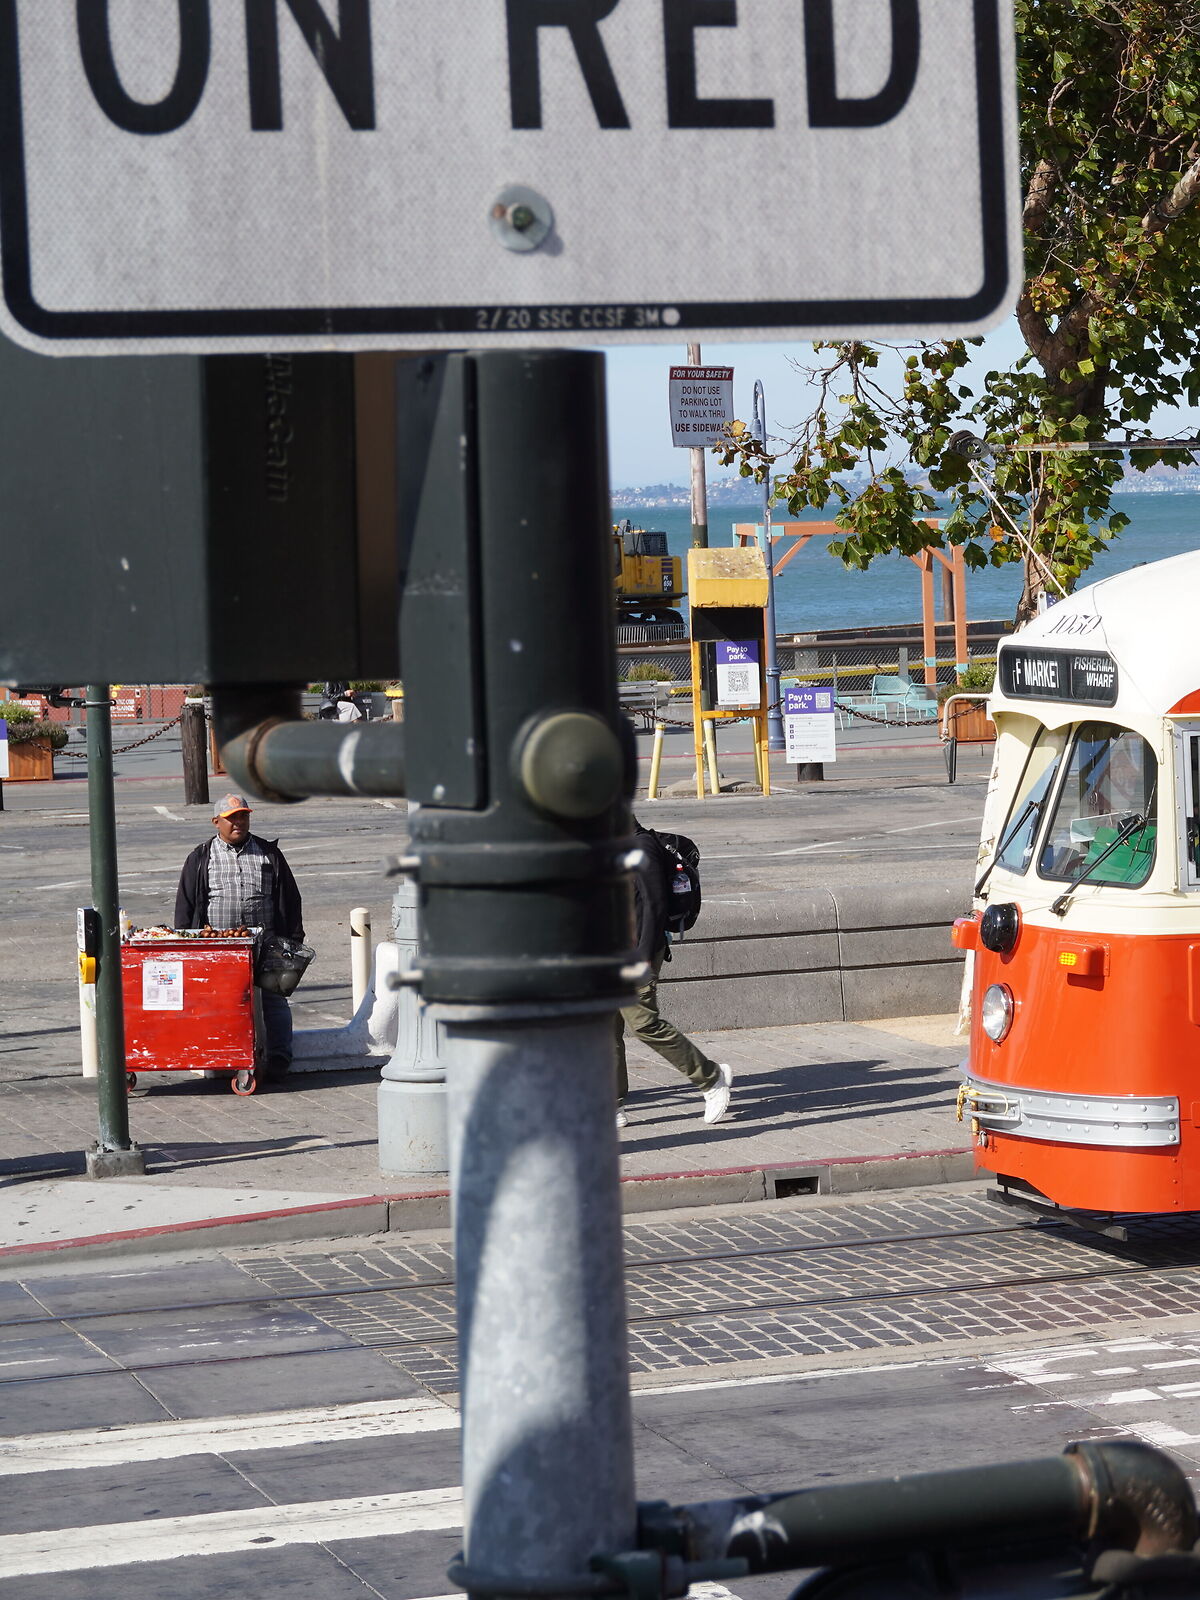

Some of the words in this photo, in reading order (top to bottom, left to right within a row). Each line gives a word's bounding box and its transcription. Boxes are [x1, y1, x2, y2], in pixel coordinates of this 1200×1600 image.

[476, 309, 531, 329] 2/20
[538, 308, 574, 329] SSC
[579, 307, 627, 328] CCSF
[634, 307, 660, 327] 3M
[672, 370, 686, 378] FOR
[687, 370, 705, 378] YOUR
[705, 370, 731, 378] SAFETY
[682, 386, 692, 395] DO
[693, 386, 706, 395] NOT
[707, 386, 720, 395] USE
[680, 398, 709, 407] PARKING
[710, 398, 722, 407] LOT
[678, 410, 688, 418] TO
[688, 410, 708, 418] WALK
[709, 410, 726, 418] THRU
[675, 423, 690, 432] USE
[1048, 614, 1102, 635] 1050
[726, 646, 740, 654] Pay
[728, 653, 747, 661] park.
[1086, 672, 1114, 688] WHARF
[788, 694, 803, 702] Pay
[788, 702, 808, 711] park.
